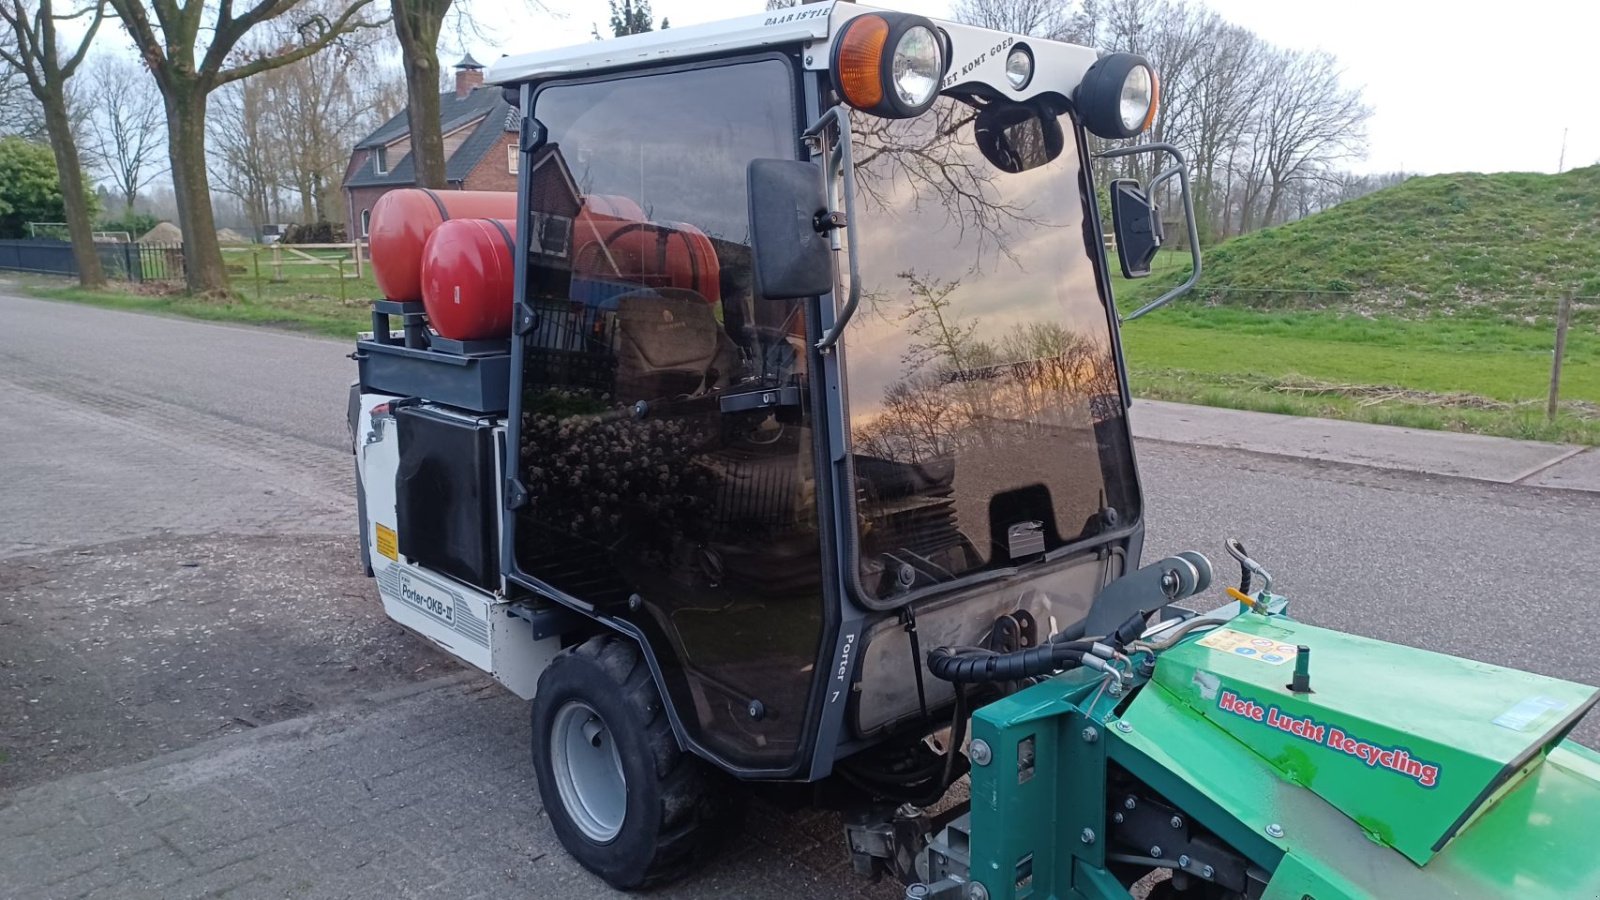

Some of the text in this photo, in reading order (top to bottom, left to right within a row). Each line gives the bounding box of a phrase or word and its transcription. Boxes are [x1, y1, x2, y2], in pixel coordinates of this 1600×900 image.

[764, 14, 794, 26] DAAR
[962, 53, 986, 76] KOMT
[990, 37, 1014, 56] GOED
[831, 633, 855, 703] Porter 7
[1219, 690, 1439, 787] Hete Lucht Recycling
